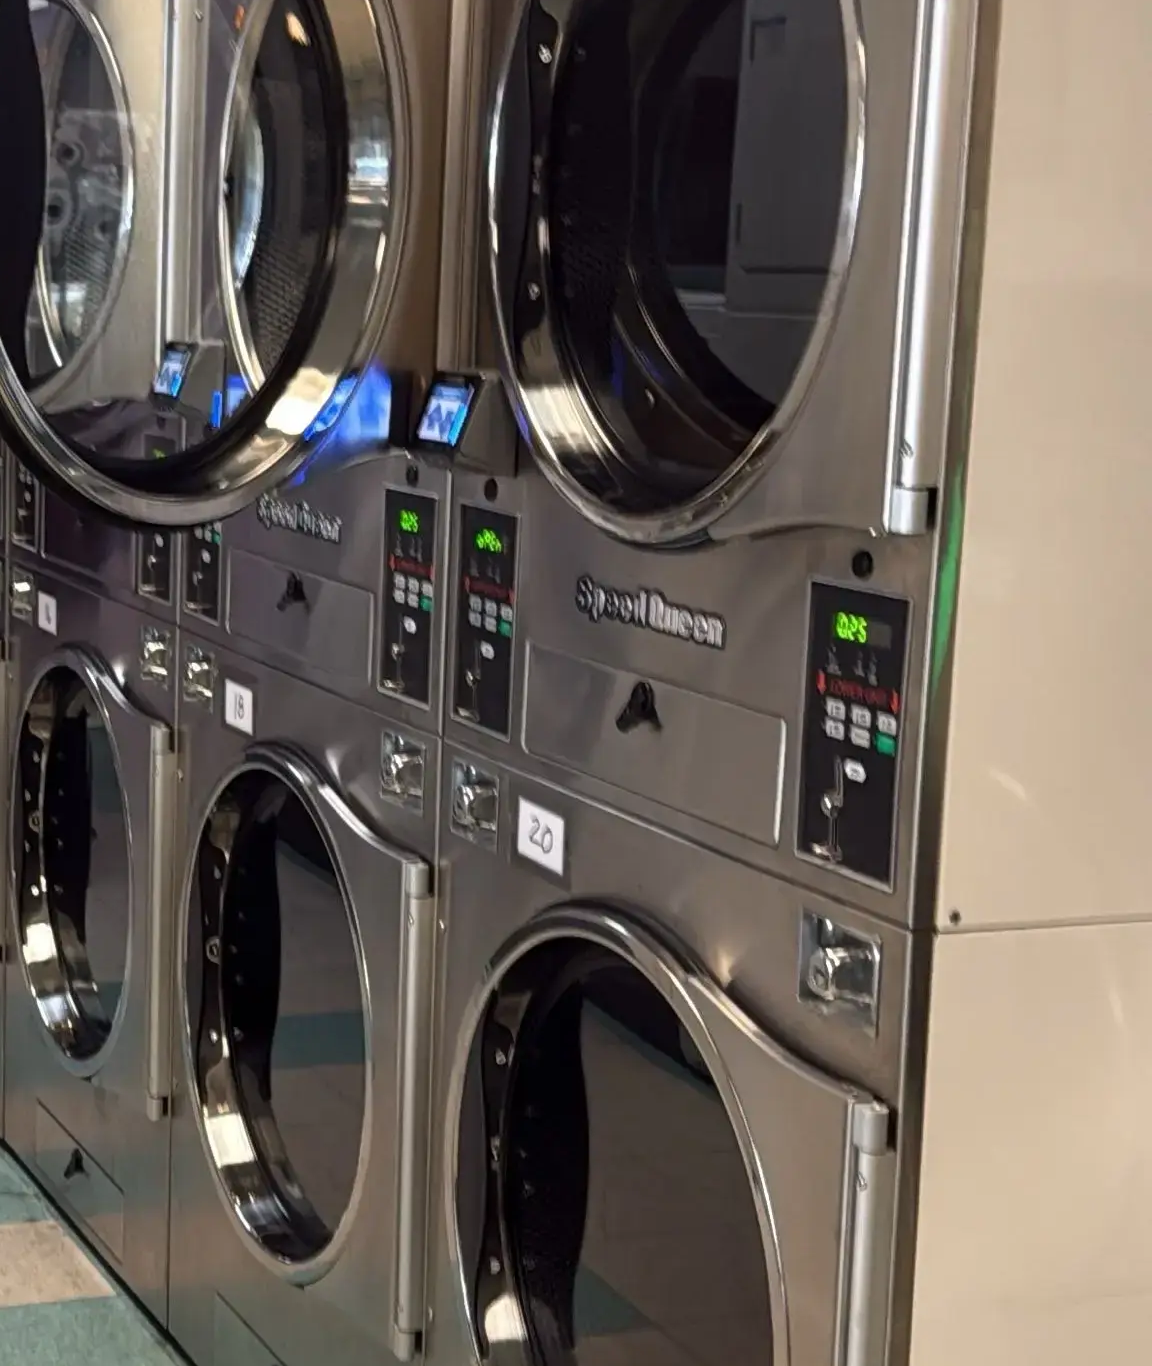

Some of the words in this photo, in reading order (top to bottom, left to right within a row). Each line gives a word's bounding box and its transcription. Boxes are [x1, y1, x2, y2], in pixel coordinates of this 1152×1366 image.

[576, 574, 647, 626] Speed
[648, 591, 726, 649] Queen
[529, 814, 554, 854] 20
